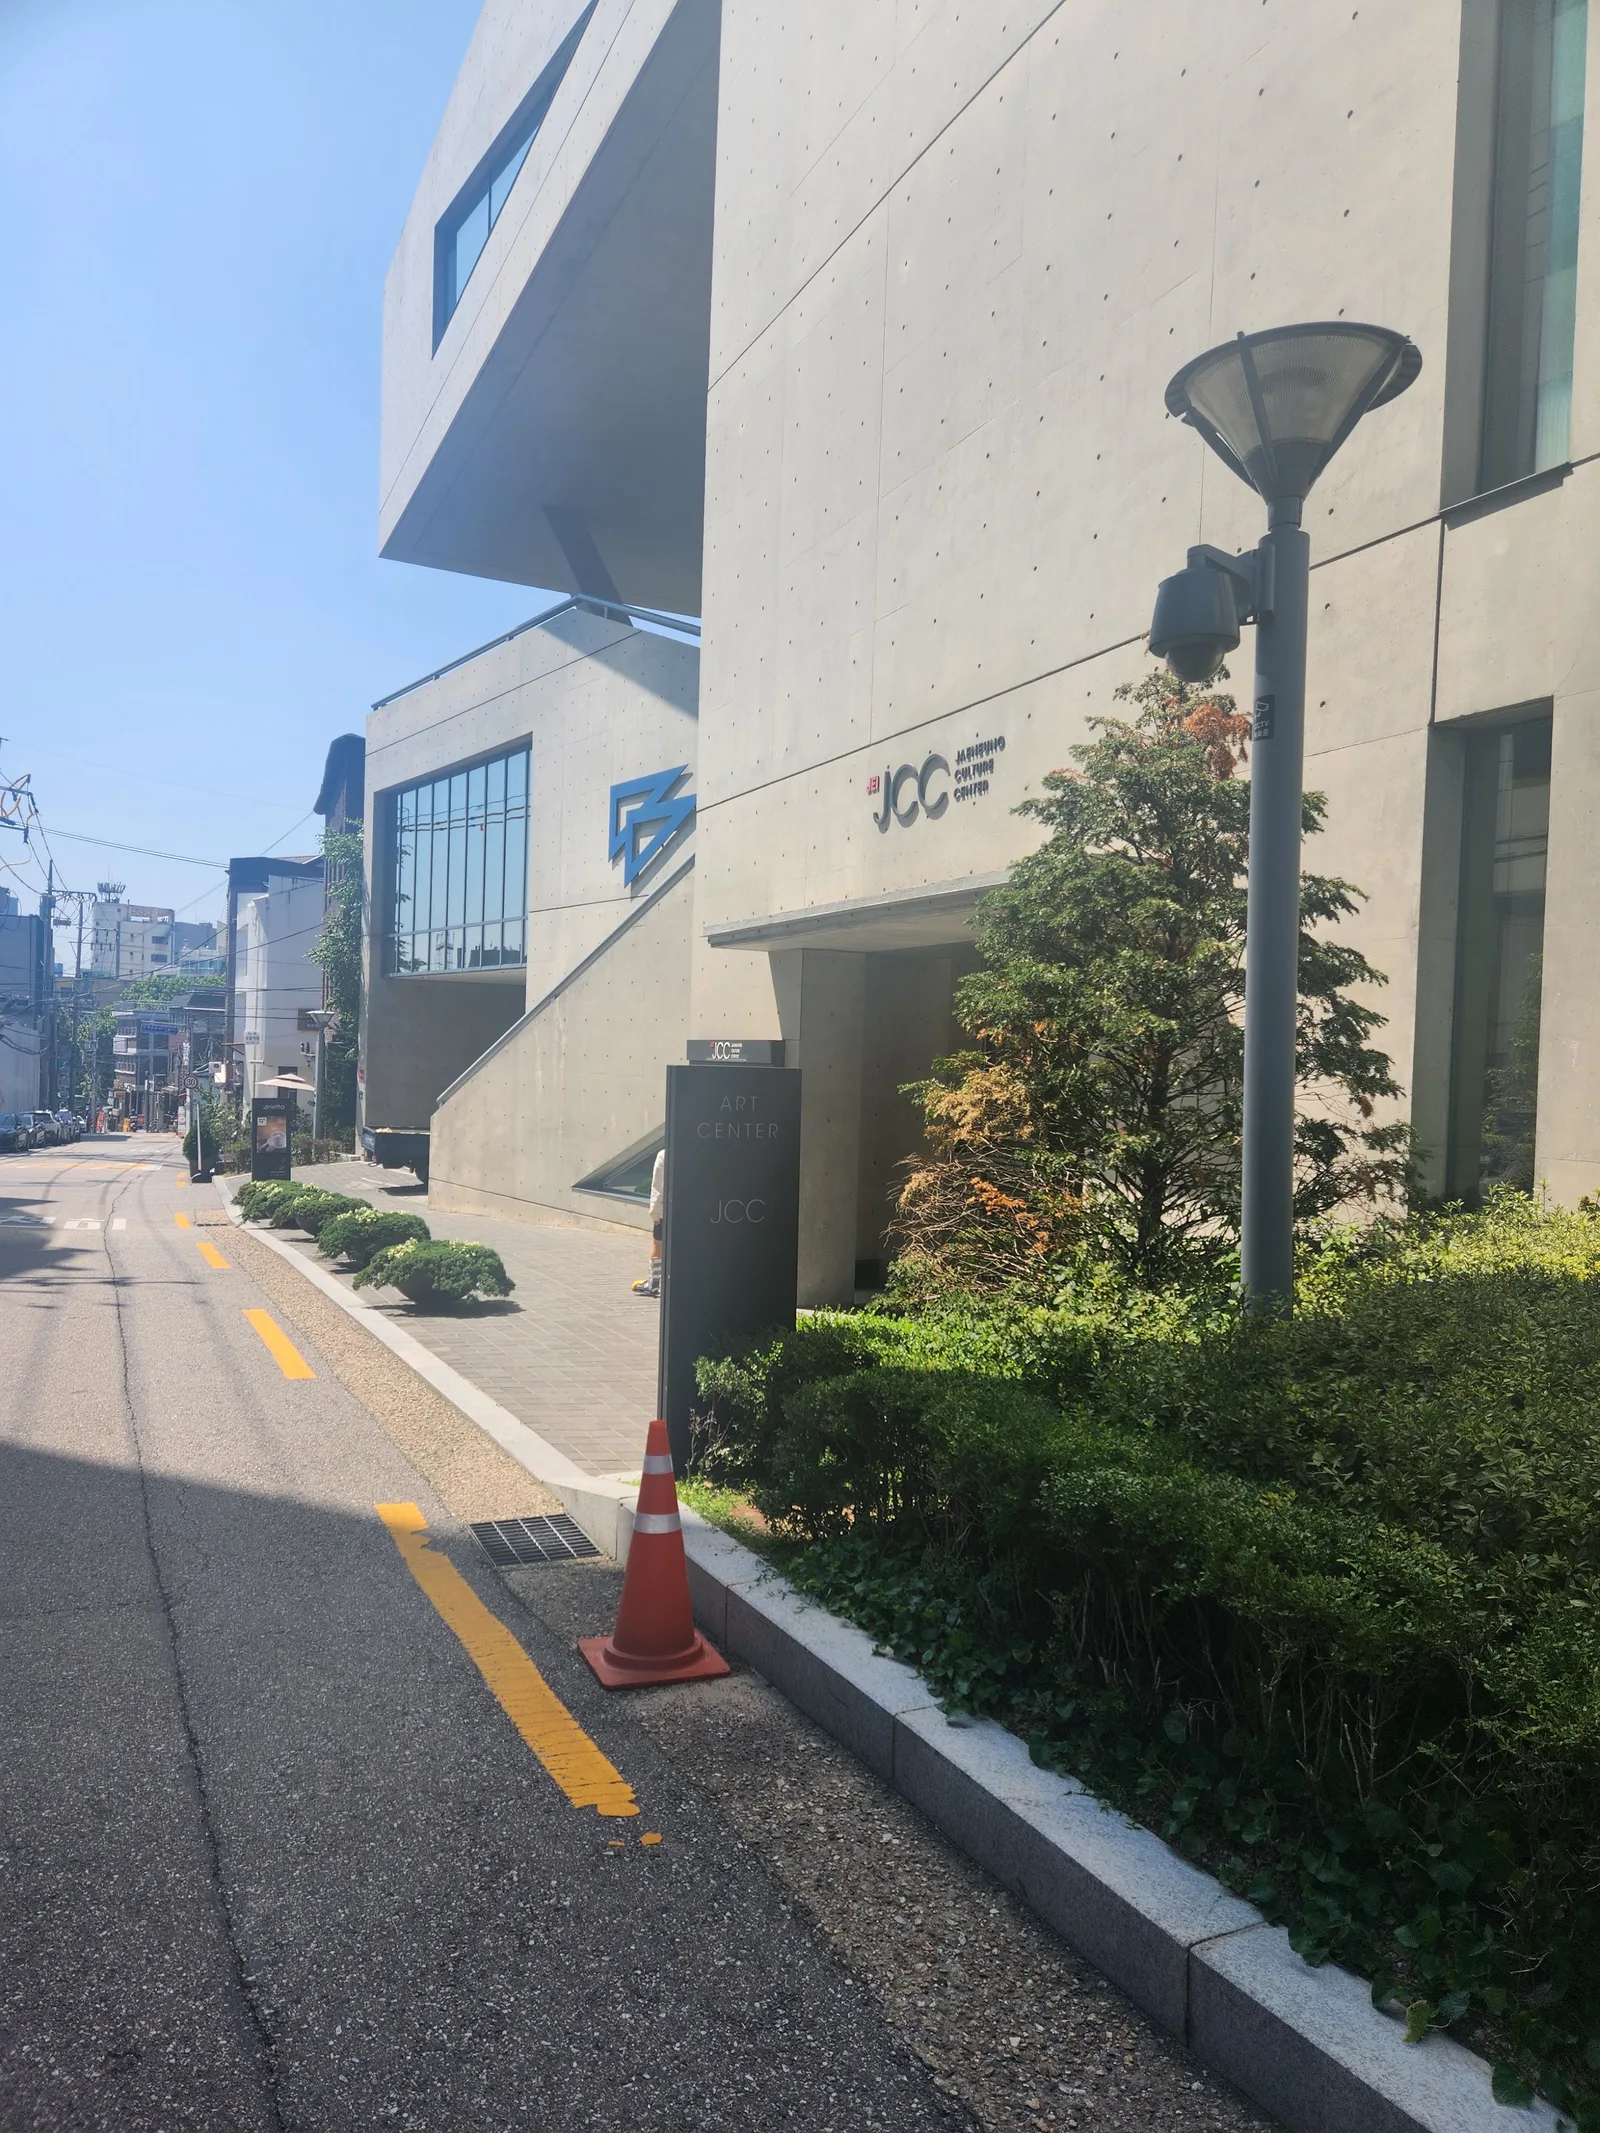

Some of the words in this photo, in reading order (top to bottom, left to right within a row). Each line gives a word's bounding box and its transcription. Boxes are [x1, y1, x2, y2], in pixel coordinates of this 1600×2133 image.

[954, 758, 995, 784] CULTURE
[867, 776, 880, 795] JEI
[873, 754, 951, 834] JCC
[953, 780, 990, 803] CENTER
[711, 1041, 731, 1060] JCC
[720, 1096, 759, 1112] ART
[697, 1122, 779, 1140] CENTER
[710, 1199, 765, 1224] JCC
